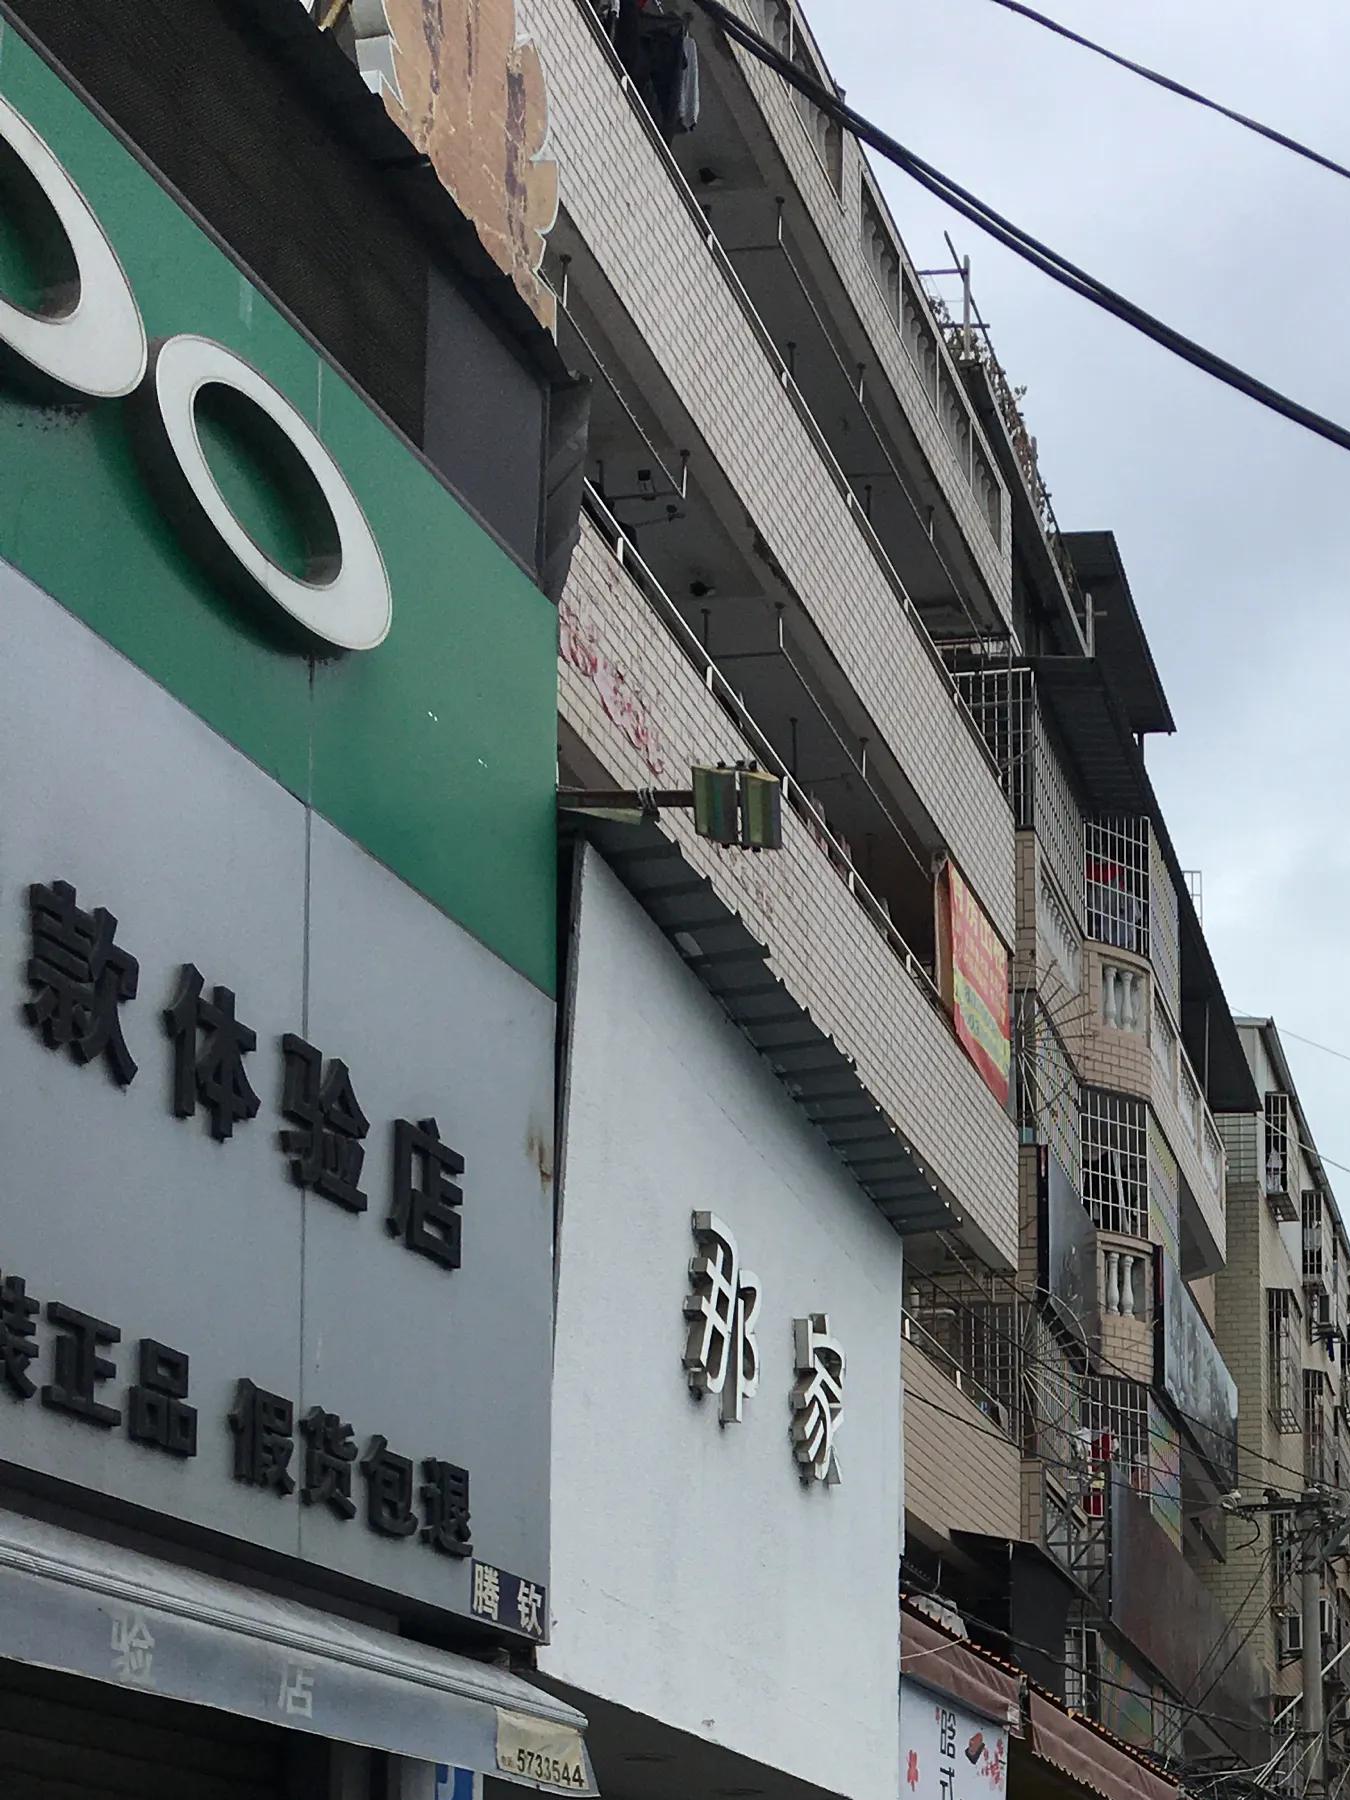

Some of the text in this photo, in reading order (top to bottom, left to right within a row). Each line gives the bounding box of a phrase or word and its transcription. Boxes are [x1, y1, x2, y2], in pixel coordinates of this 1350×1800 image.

[23, 880, 466, 1270] 款体验店
[229, 1377, 474, 1557] 假货包退
[517, 1748, 585, 1788] 5733544
